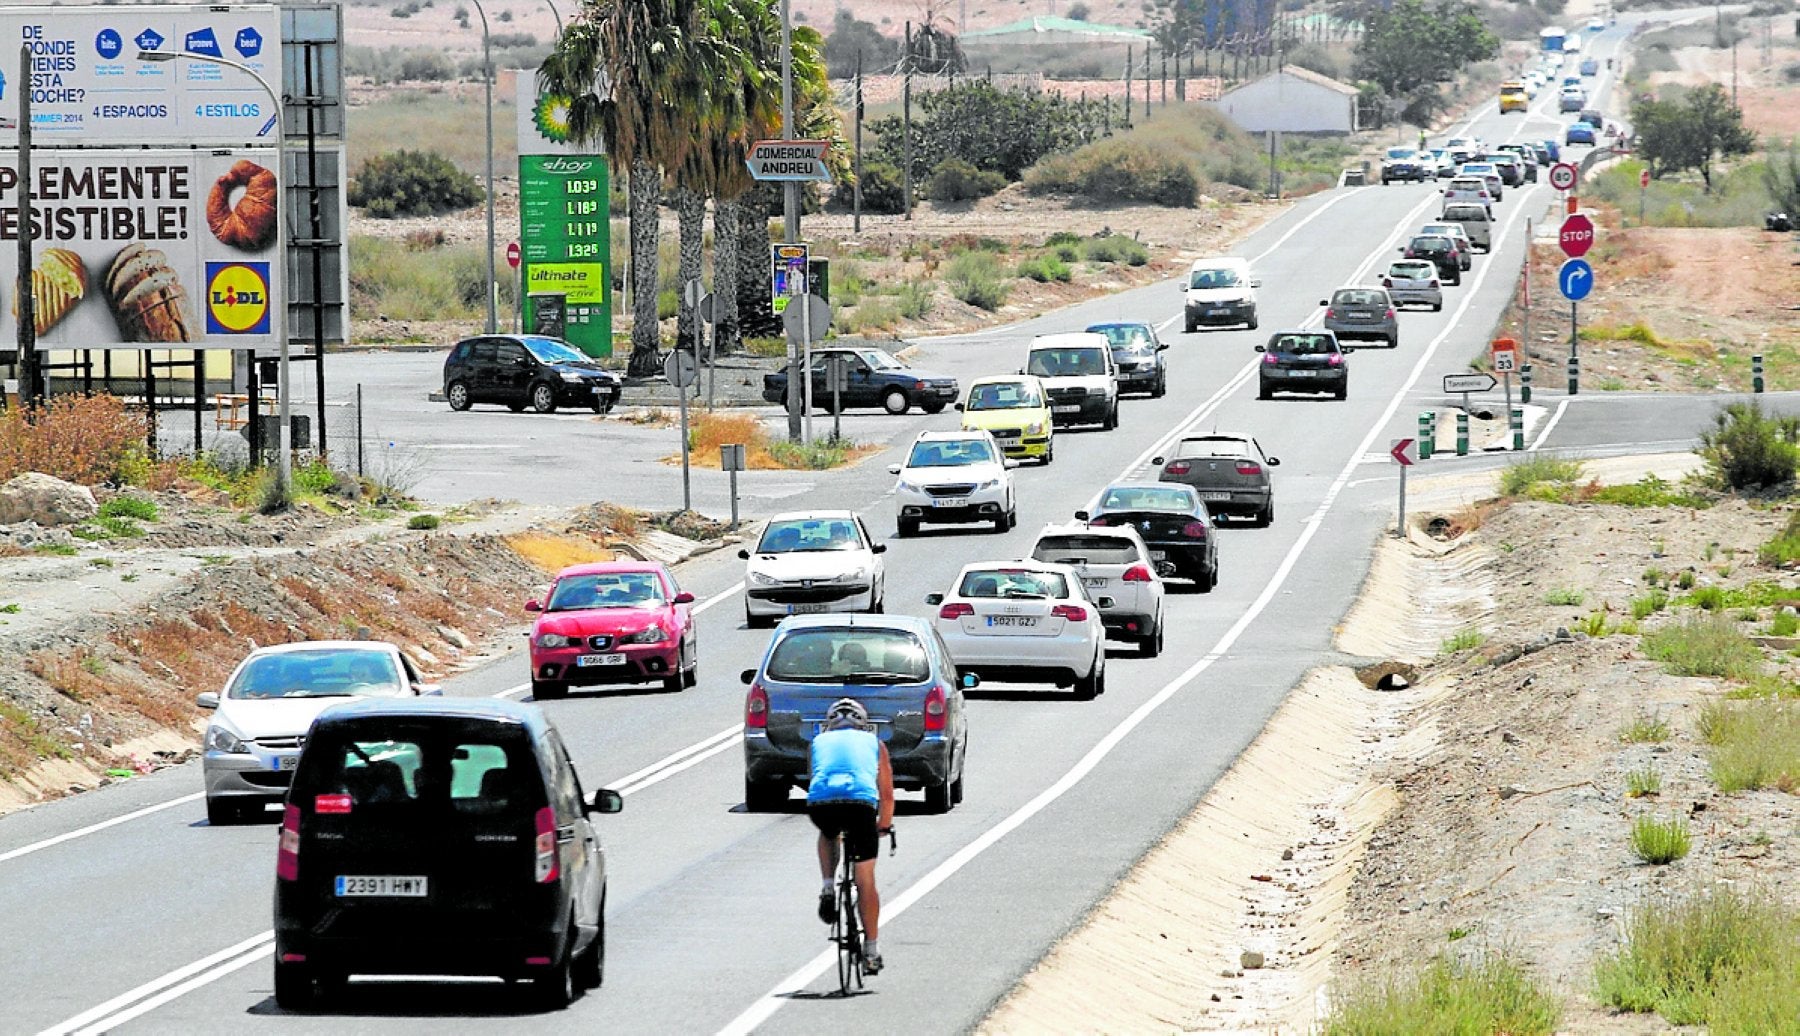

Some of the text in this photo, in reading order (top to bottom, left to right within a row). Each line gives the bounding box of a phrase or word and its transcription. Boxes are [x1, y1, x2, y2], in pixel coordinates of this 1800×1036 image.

[22, 25, 42, 39] DE
[188, 40, 214, 50] groove
[240, 39, 257, 48] beat
[30, 57, 76, 71] IENES
[92, 105, 168, 118] 4 ESPACIOS
[195, 104, 260, 117] 4 ESTILOS
[31, 114, 84, 123] UMMER 2014
[756, 147, 818, 159] COMERCIAL
[541, 157, 593, 171] shop
[761, 162, 814, 174] ANDREU
[1554, 172, 1571, 181] 80
[0, 166, 189, 200] PEMENTE
[1562, 230, 1592, 241] STOP
[531, 270, 588, 281] ultimate
[1497, 359, 1513, 370] 33
[993, 616, 1037, 626] 5021 GZJ
[347, 878, 424, 894] 2391 HWY
